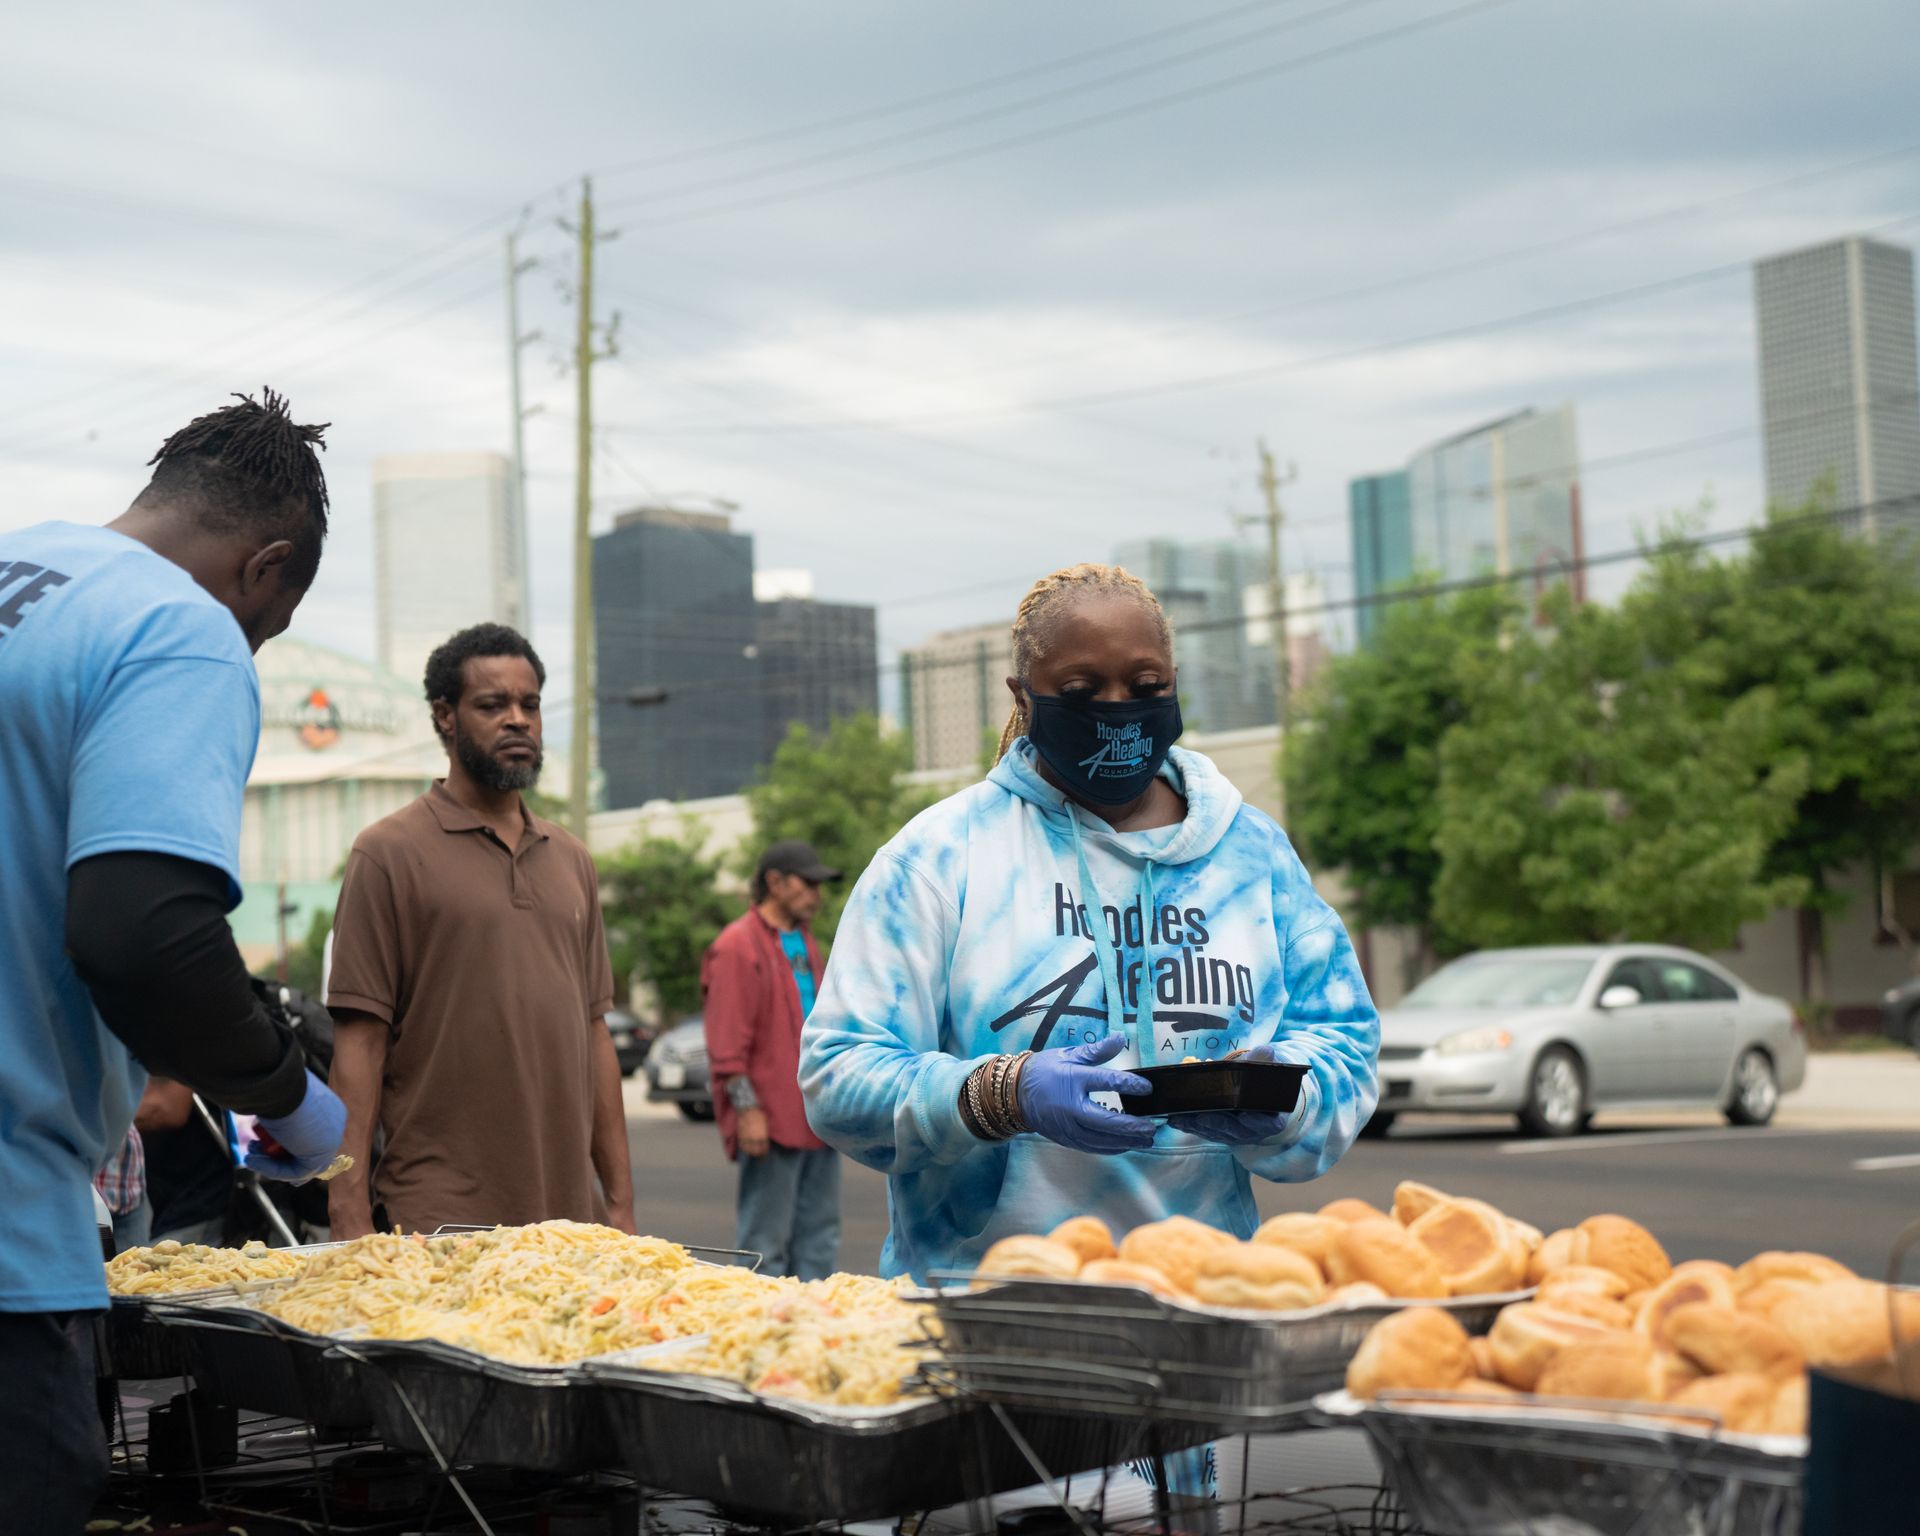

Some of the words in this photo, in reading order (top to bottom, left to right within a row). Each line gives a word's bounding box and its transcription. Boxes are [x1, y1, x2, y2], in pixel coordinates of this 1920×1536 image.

[0, 561, 73, 630] TE
[1096, 721, 1142, 740] Hoodies
[1111, 736, 1153, 760] Healing
[1055, 882, 1210, 948] Hoodies
[1067, 1028, 1240, 1051] FOATION
